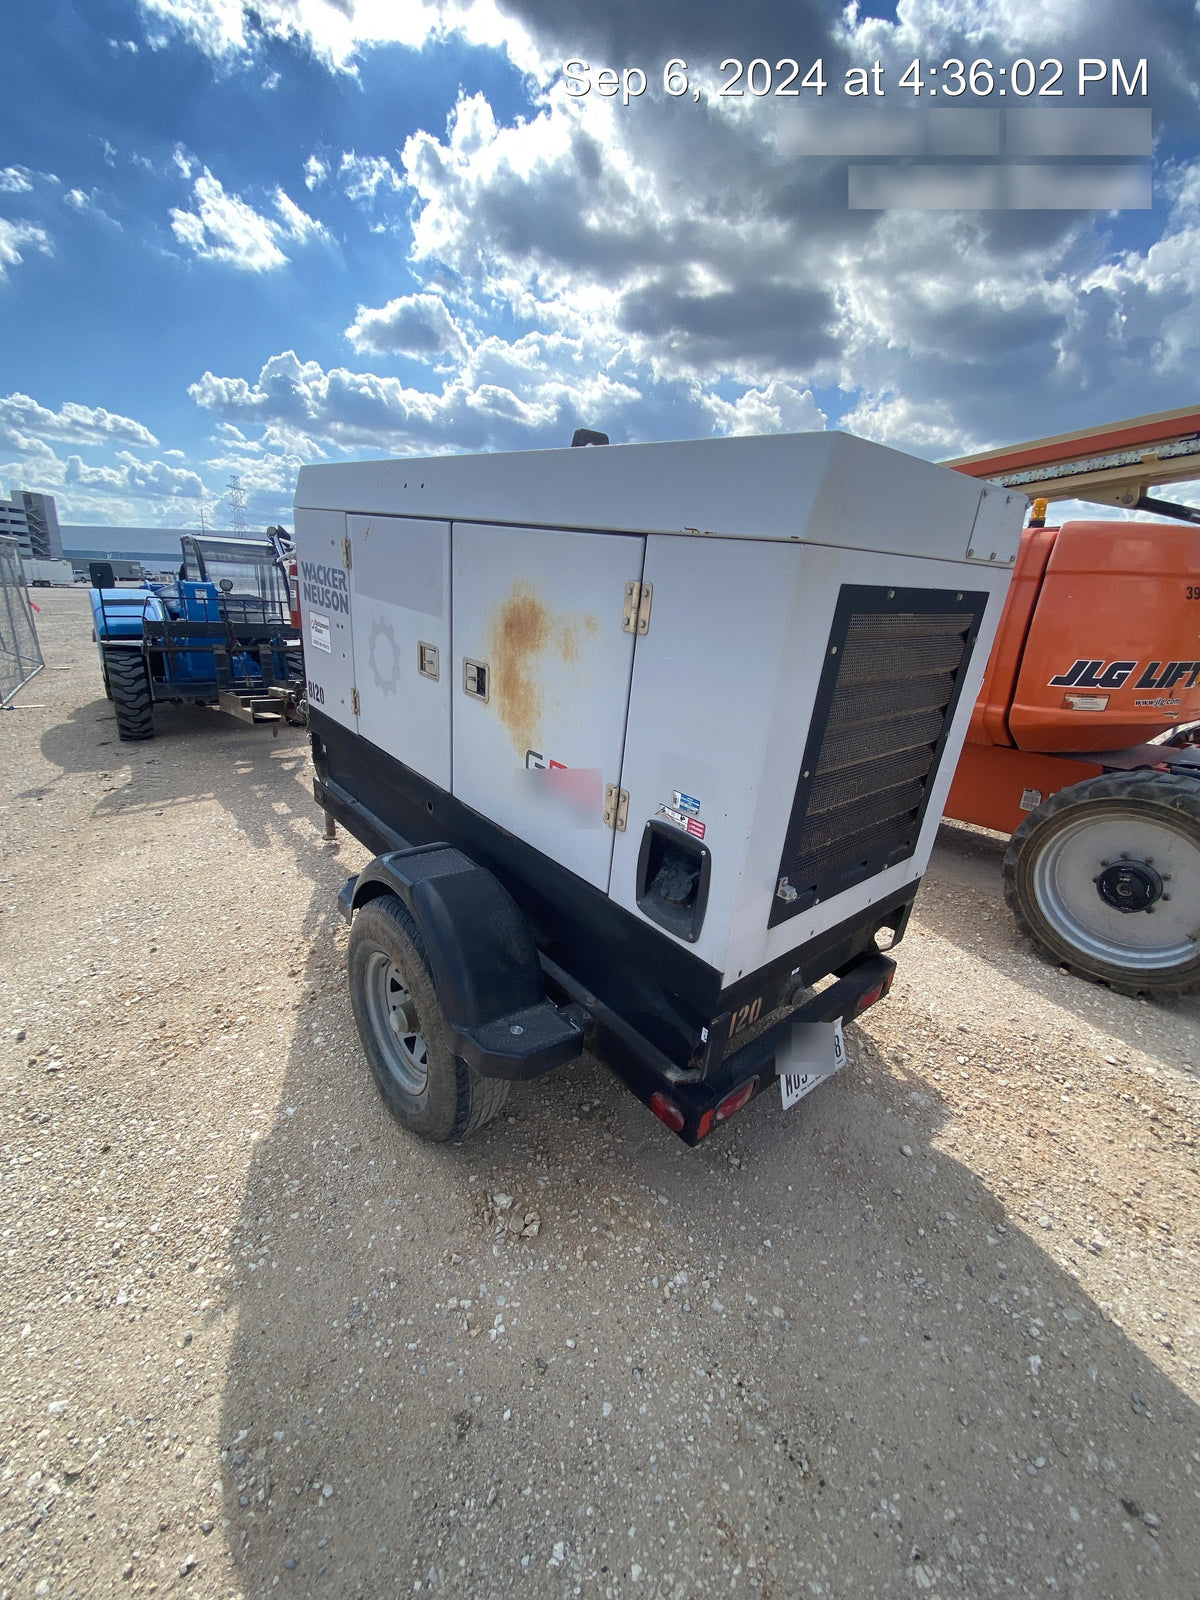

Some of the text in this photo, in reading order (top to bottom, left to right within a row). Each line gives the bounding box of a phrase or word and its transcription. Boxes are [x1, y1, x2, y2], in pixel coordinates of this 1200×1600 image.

[301, 561, 348, 592] WACKER
[303, 582, 349, 615] NEUSON
[1047, 659, 1138, 690] JLG
[1134, 697, 1181, 708] www.jlg.com
[728, 996, 763, 1038] 120
